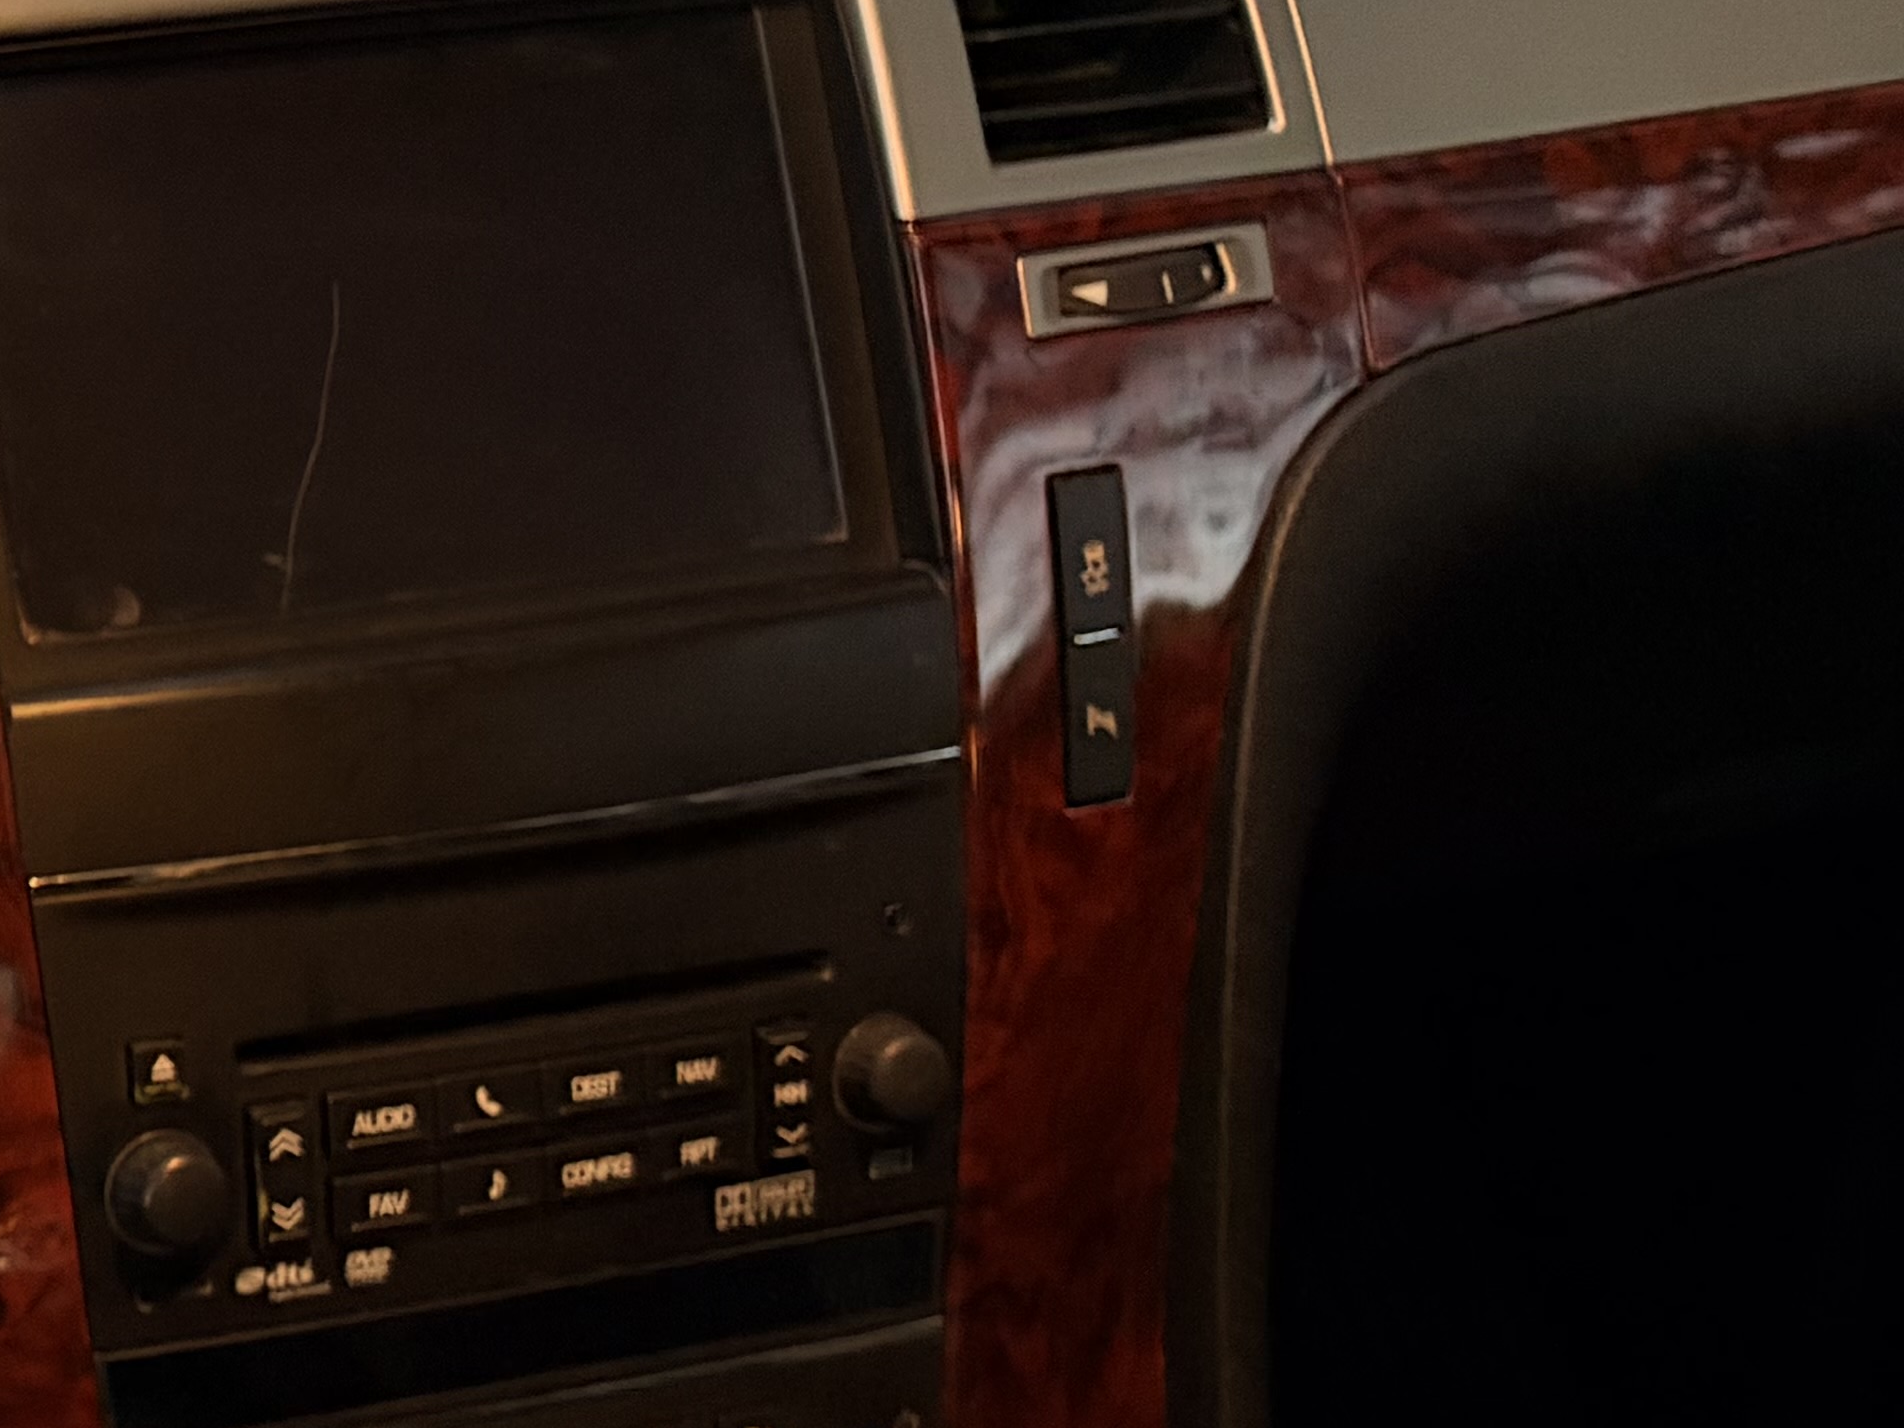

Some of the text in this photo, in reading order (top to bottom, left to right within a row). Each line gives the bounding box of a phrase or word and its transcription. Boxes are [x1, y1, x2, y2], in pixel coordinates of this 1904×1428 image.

[570, 1070, 623, 1103] DEST
[675, 1056, 719, 1086] NAV
[351, 1103, 416, 1138] AUDIO
[368, 1189, 410, 1221] FAV
